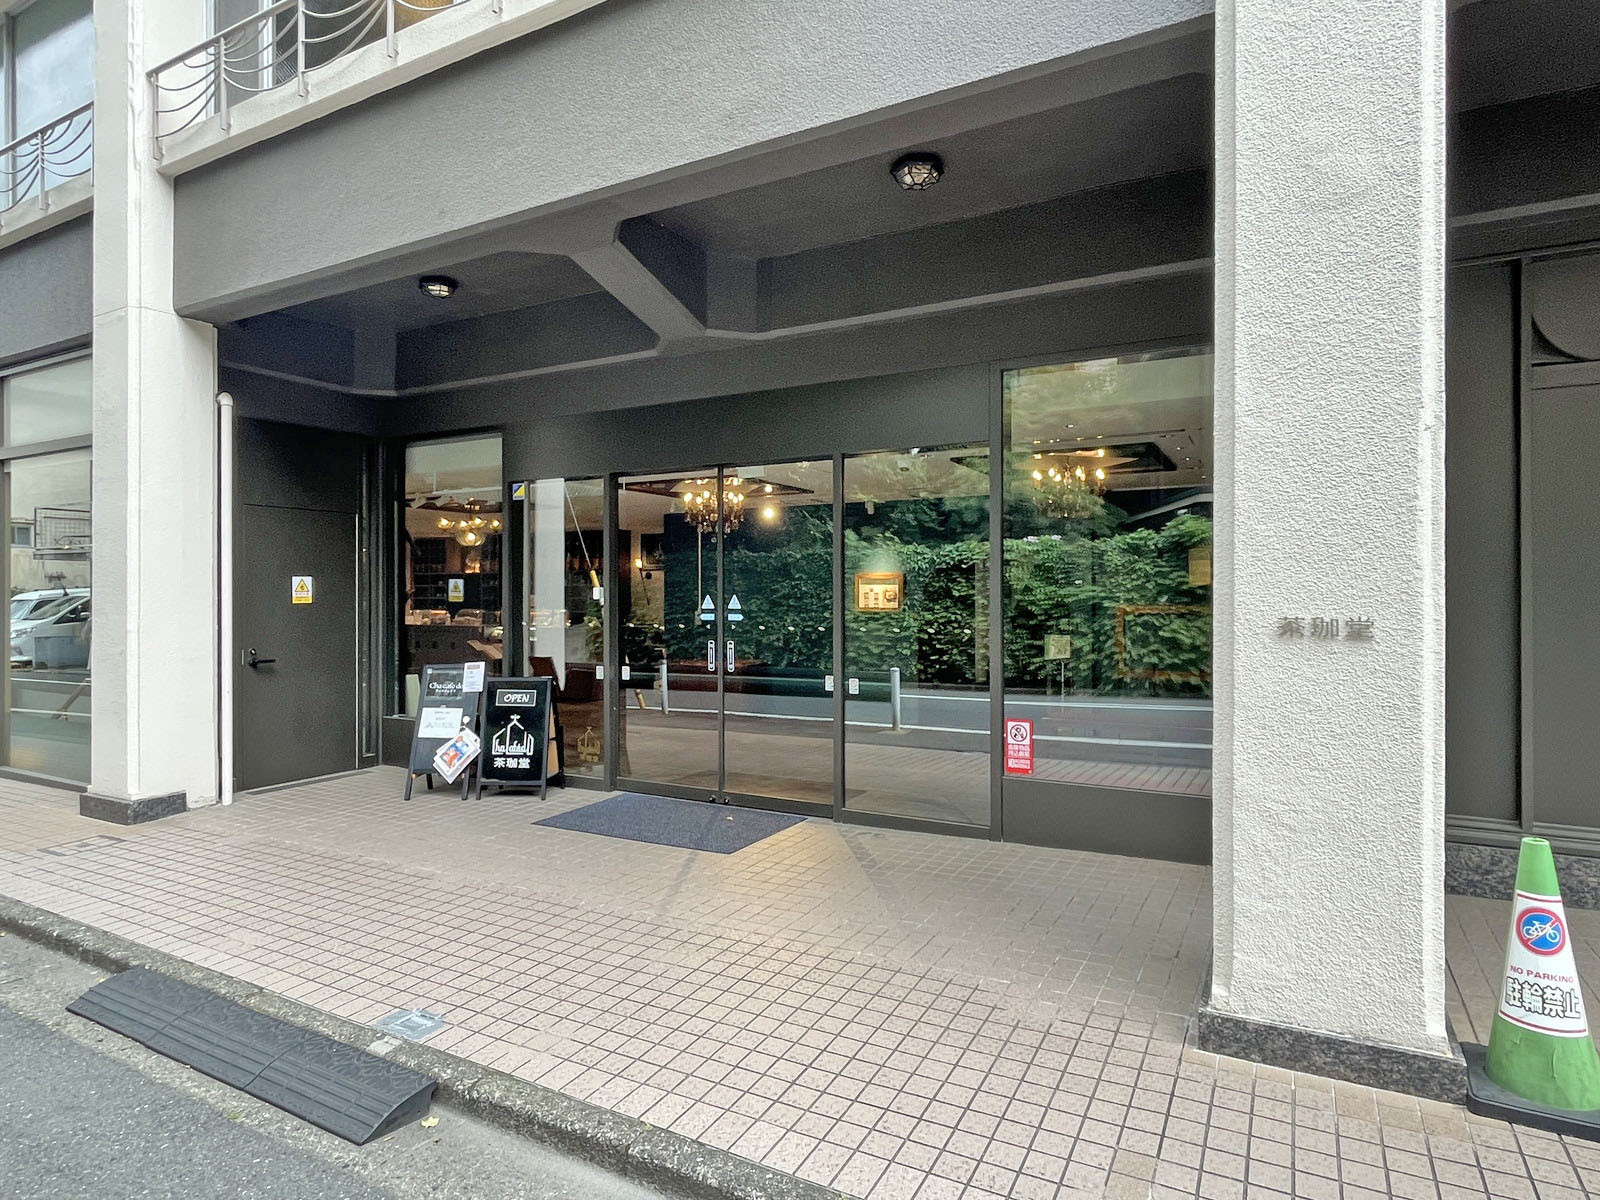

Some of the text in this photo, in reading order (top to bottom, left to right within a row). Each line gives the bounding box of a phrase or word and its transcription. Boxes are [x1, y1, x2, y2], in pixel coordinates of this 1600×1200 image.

[1277, 616, 1375, 640] 茶珈堂
[503, 693, 530, 703] OPEN
[493, 757, 530, 769] 茶珈堂
[1510, 965, 1574, 983] NO PARKING
[1505, 976, 1581, 1019] 駐輪禁止
